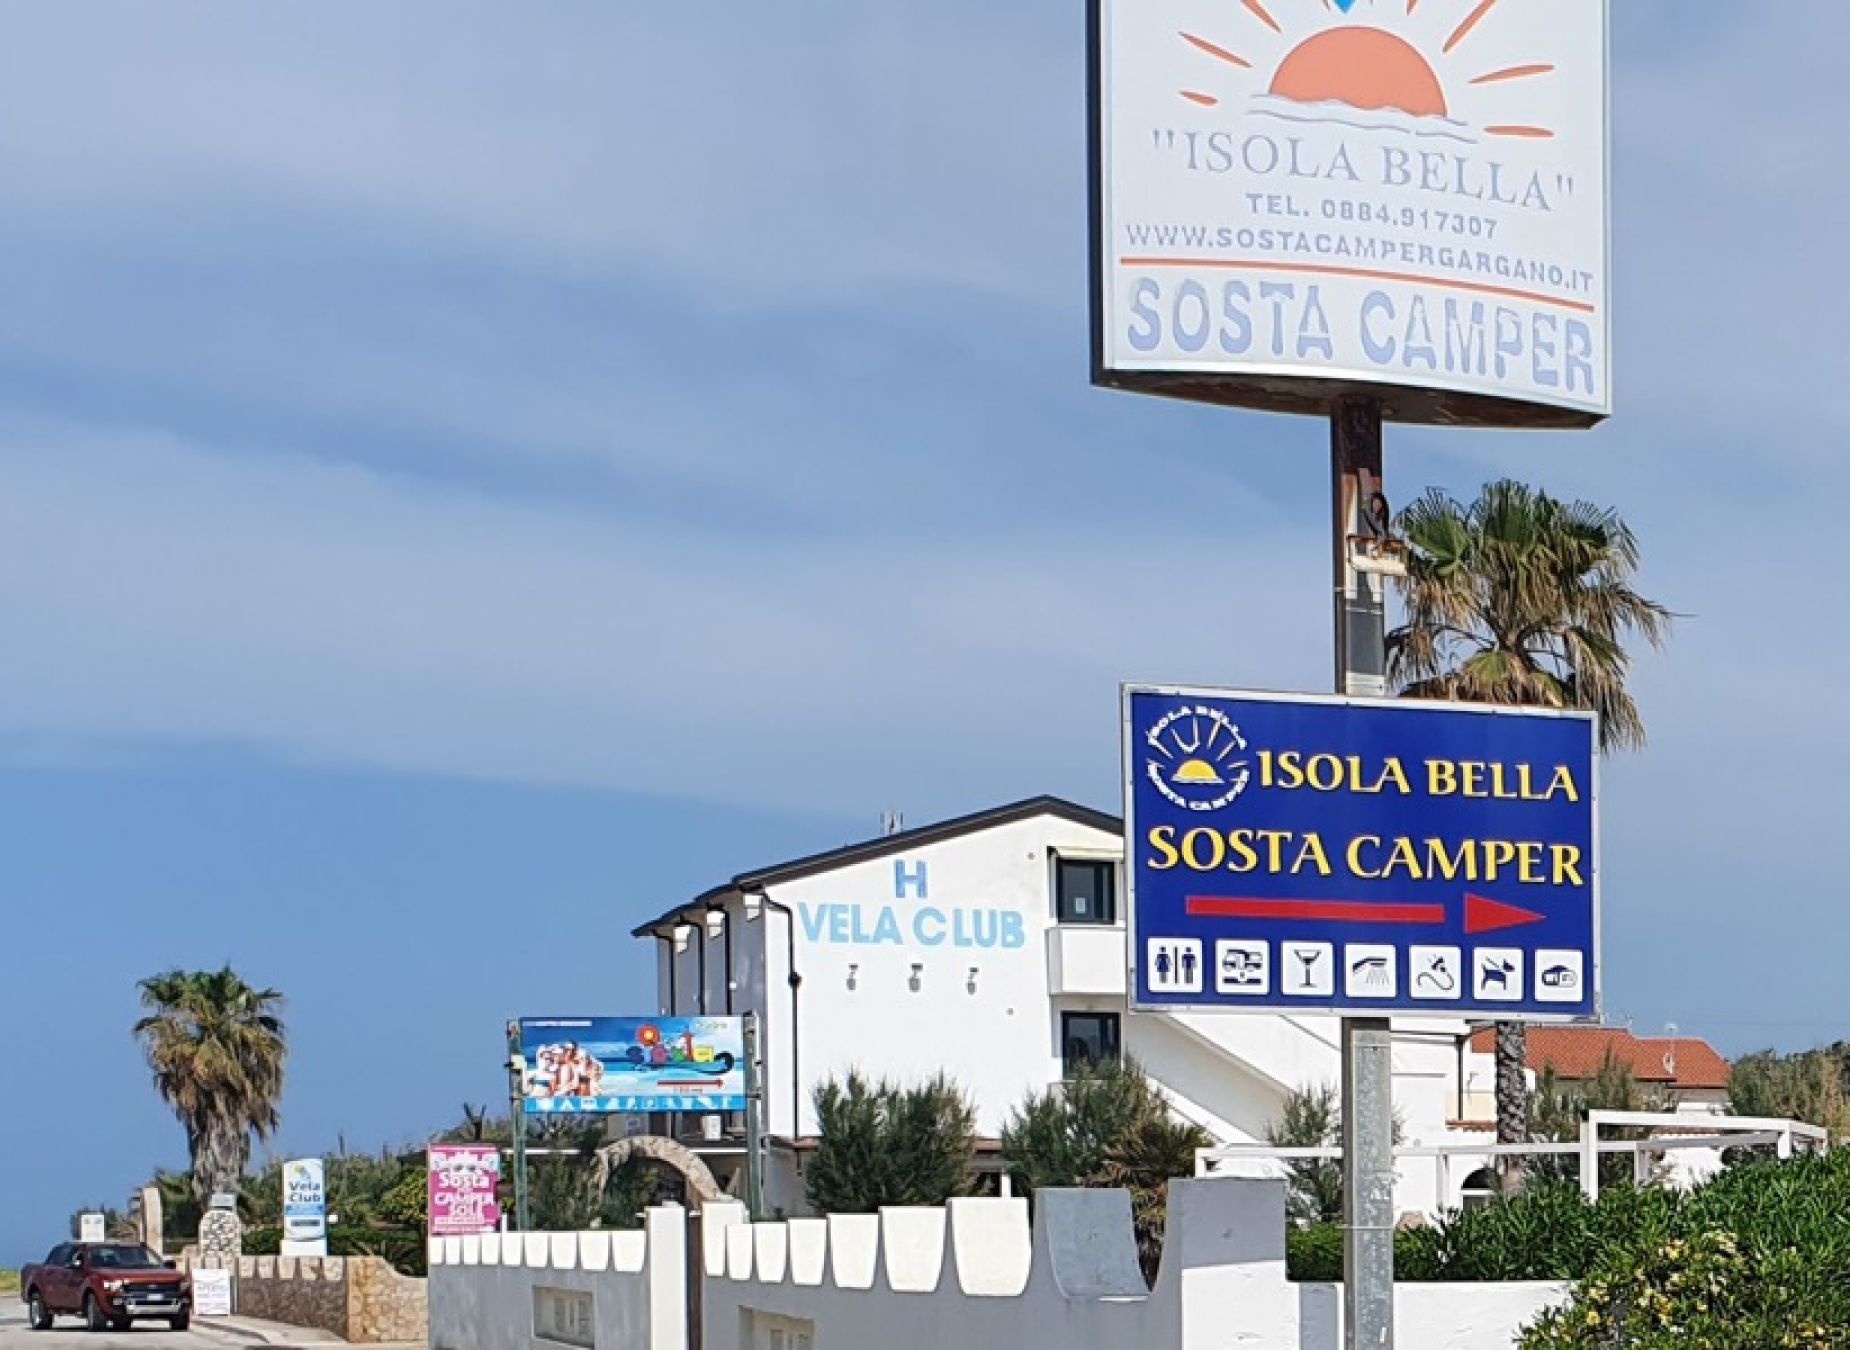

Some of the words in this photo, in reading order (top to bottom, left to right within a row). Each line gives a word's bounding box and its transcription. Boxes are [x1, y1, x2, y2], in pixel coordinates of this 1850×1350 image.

[1246, 193, 1310, 217] TEL.
[1321, 199, 1498, 239] 0884.917307
[1126, 224, 1594, 293] WWW.SOSTACAMPERGARGANO.IT
[1127, 276, 1334, 361] SOSTA
[1360, 289, 1595, 395] CAMPER
[1256, 750, 1412, 794] ISOLA
[1424, 759, 1580, 802] BELLA
[893, 859, 928, 899] H
[1147, 825, 1332, 876] SOSTA
[1346, 835, 1585, 886] CAMPER
[797, 902, 903, 946] VELA
[911, 905, 1025, 949] CLUB
[288, 1192, 321, 1203] Club
